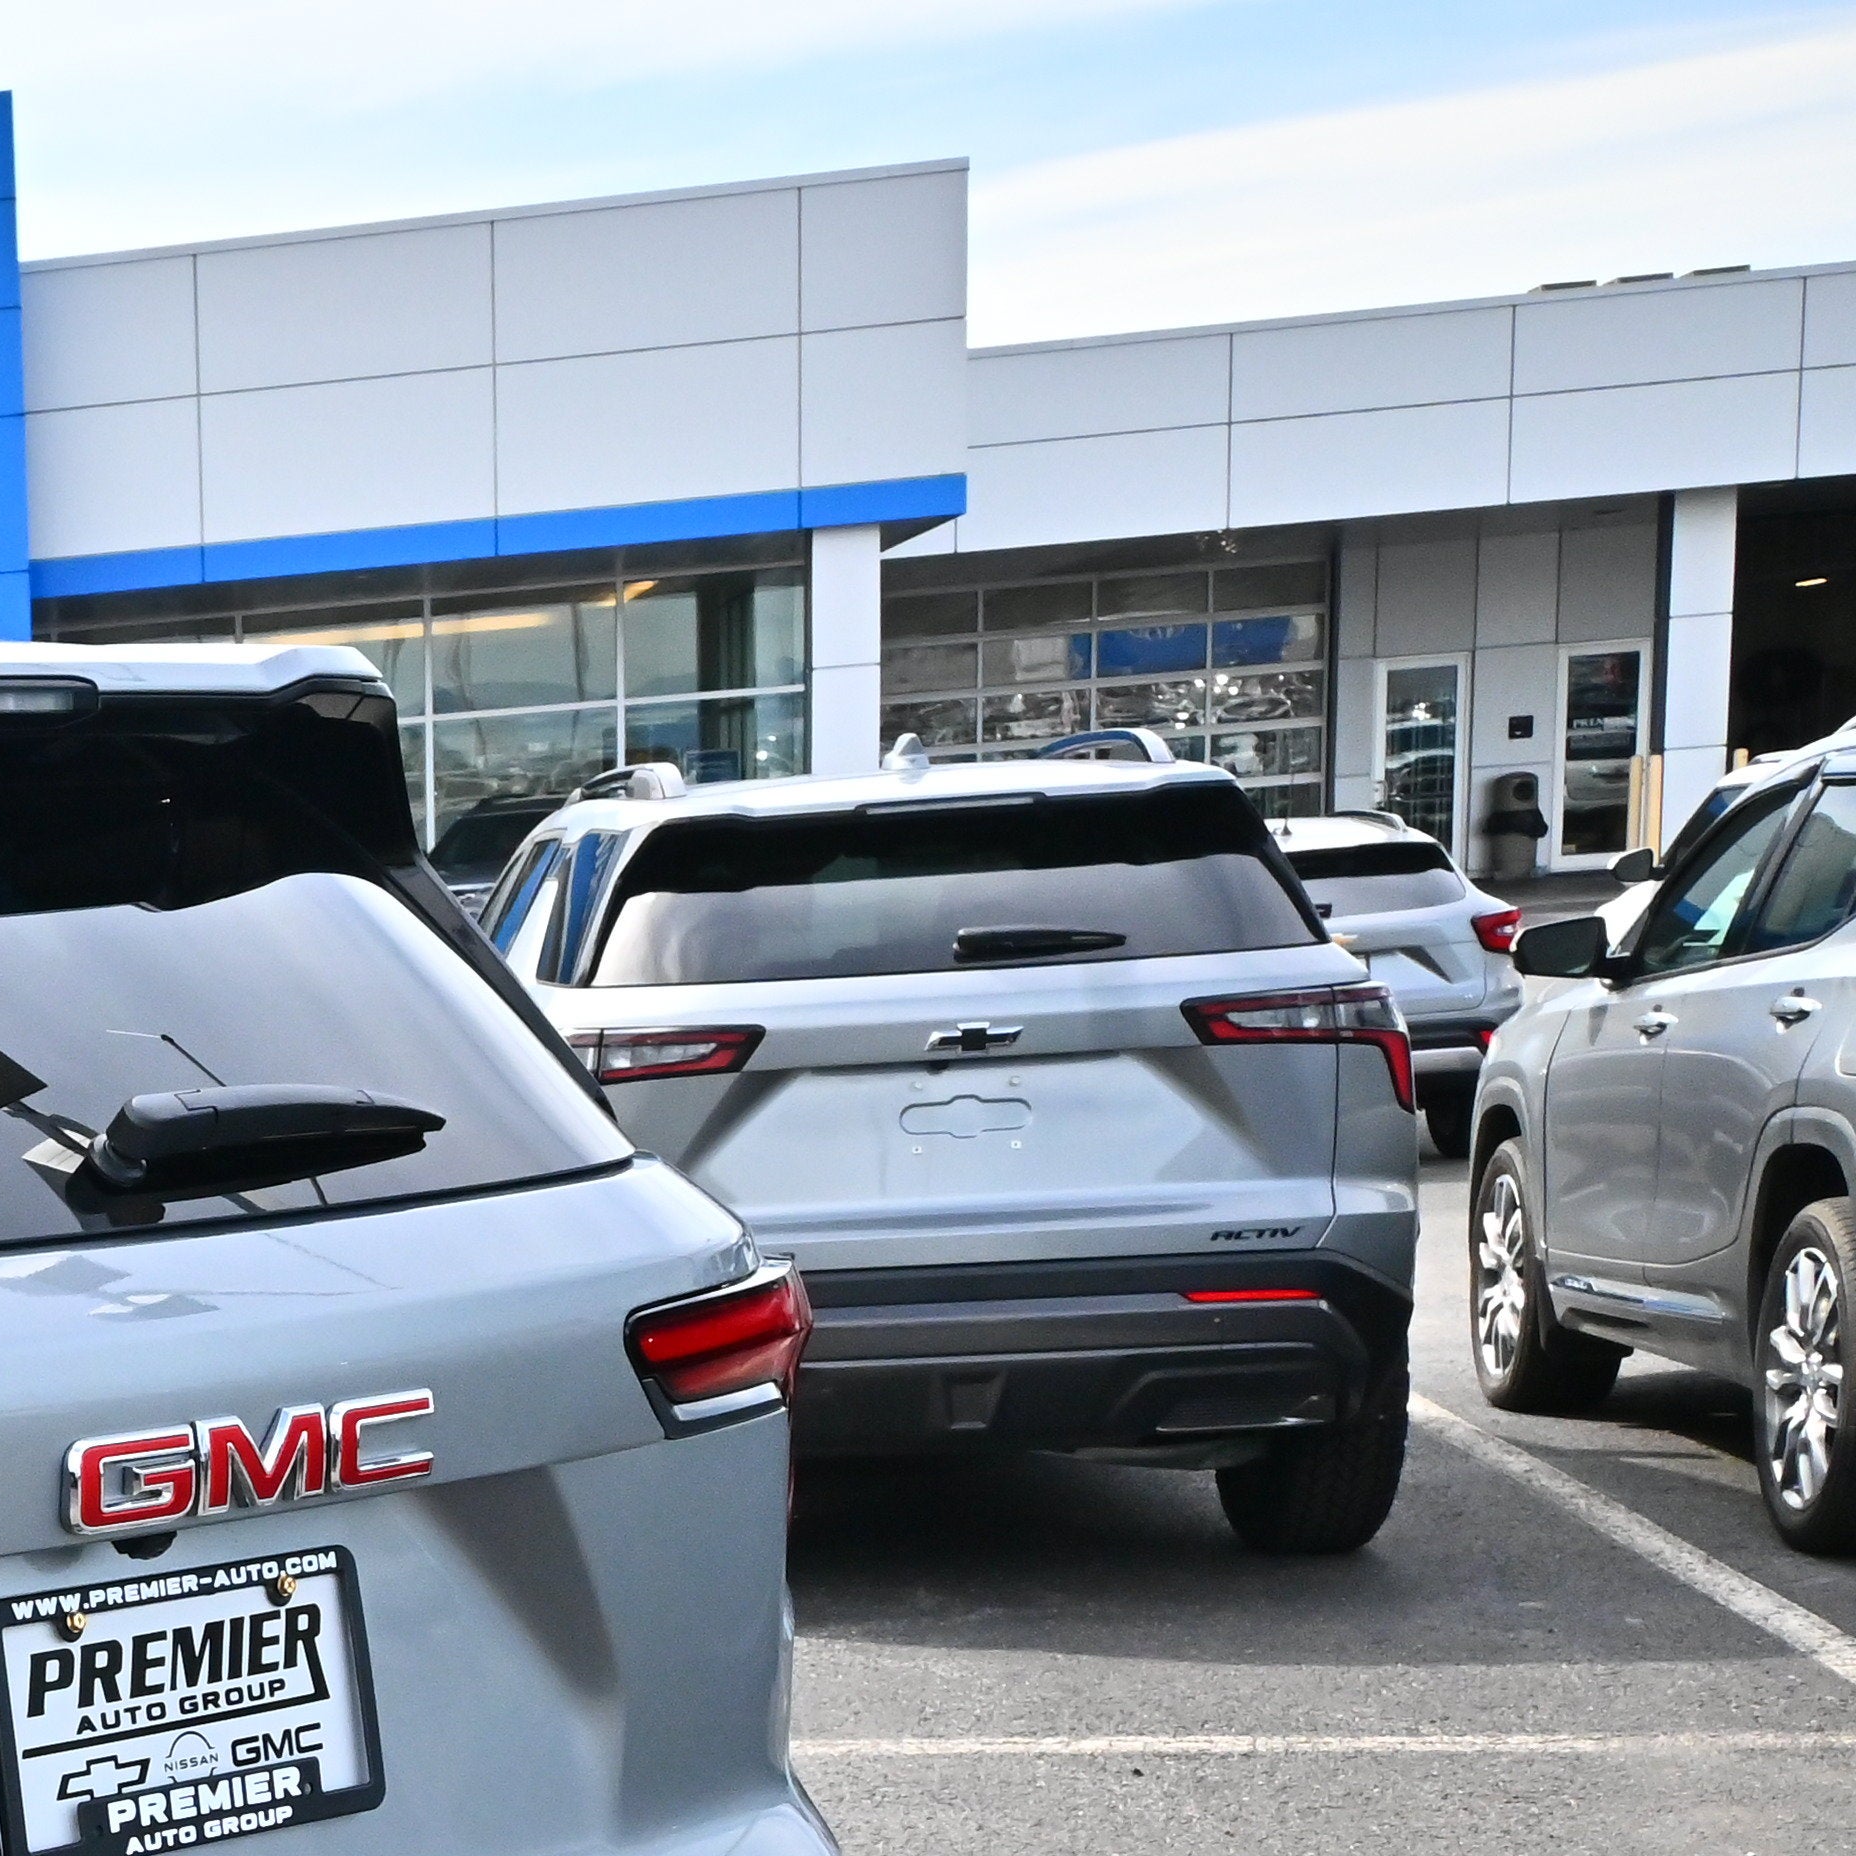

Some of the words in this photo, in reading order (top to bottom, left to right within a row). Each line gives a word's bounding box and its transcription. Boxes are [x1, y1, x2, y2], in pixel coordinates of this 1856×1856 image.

[63, 1388, 435, 1534] GMC
[11, 1551, 338, 1621] WWW.PREMIER-AUTO.COM
[26, 1603, 330, 1718] PREMIER
[76, 1700, 166, 1735] AUTO
[178, 1678, 286, 1715] GROUP
[164, 1752, 219, 1773] NISSAN
[230, 1722, 324, 1767] GMC
[107, 1766, 302, 1834] PREMIER
[125, 1824, 196, 1855] AUTO
[203, 1805, 293, 1838] GROUP
